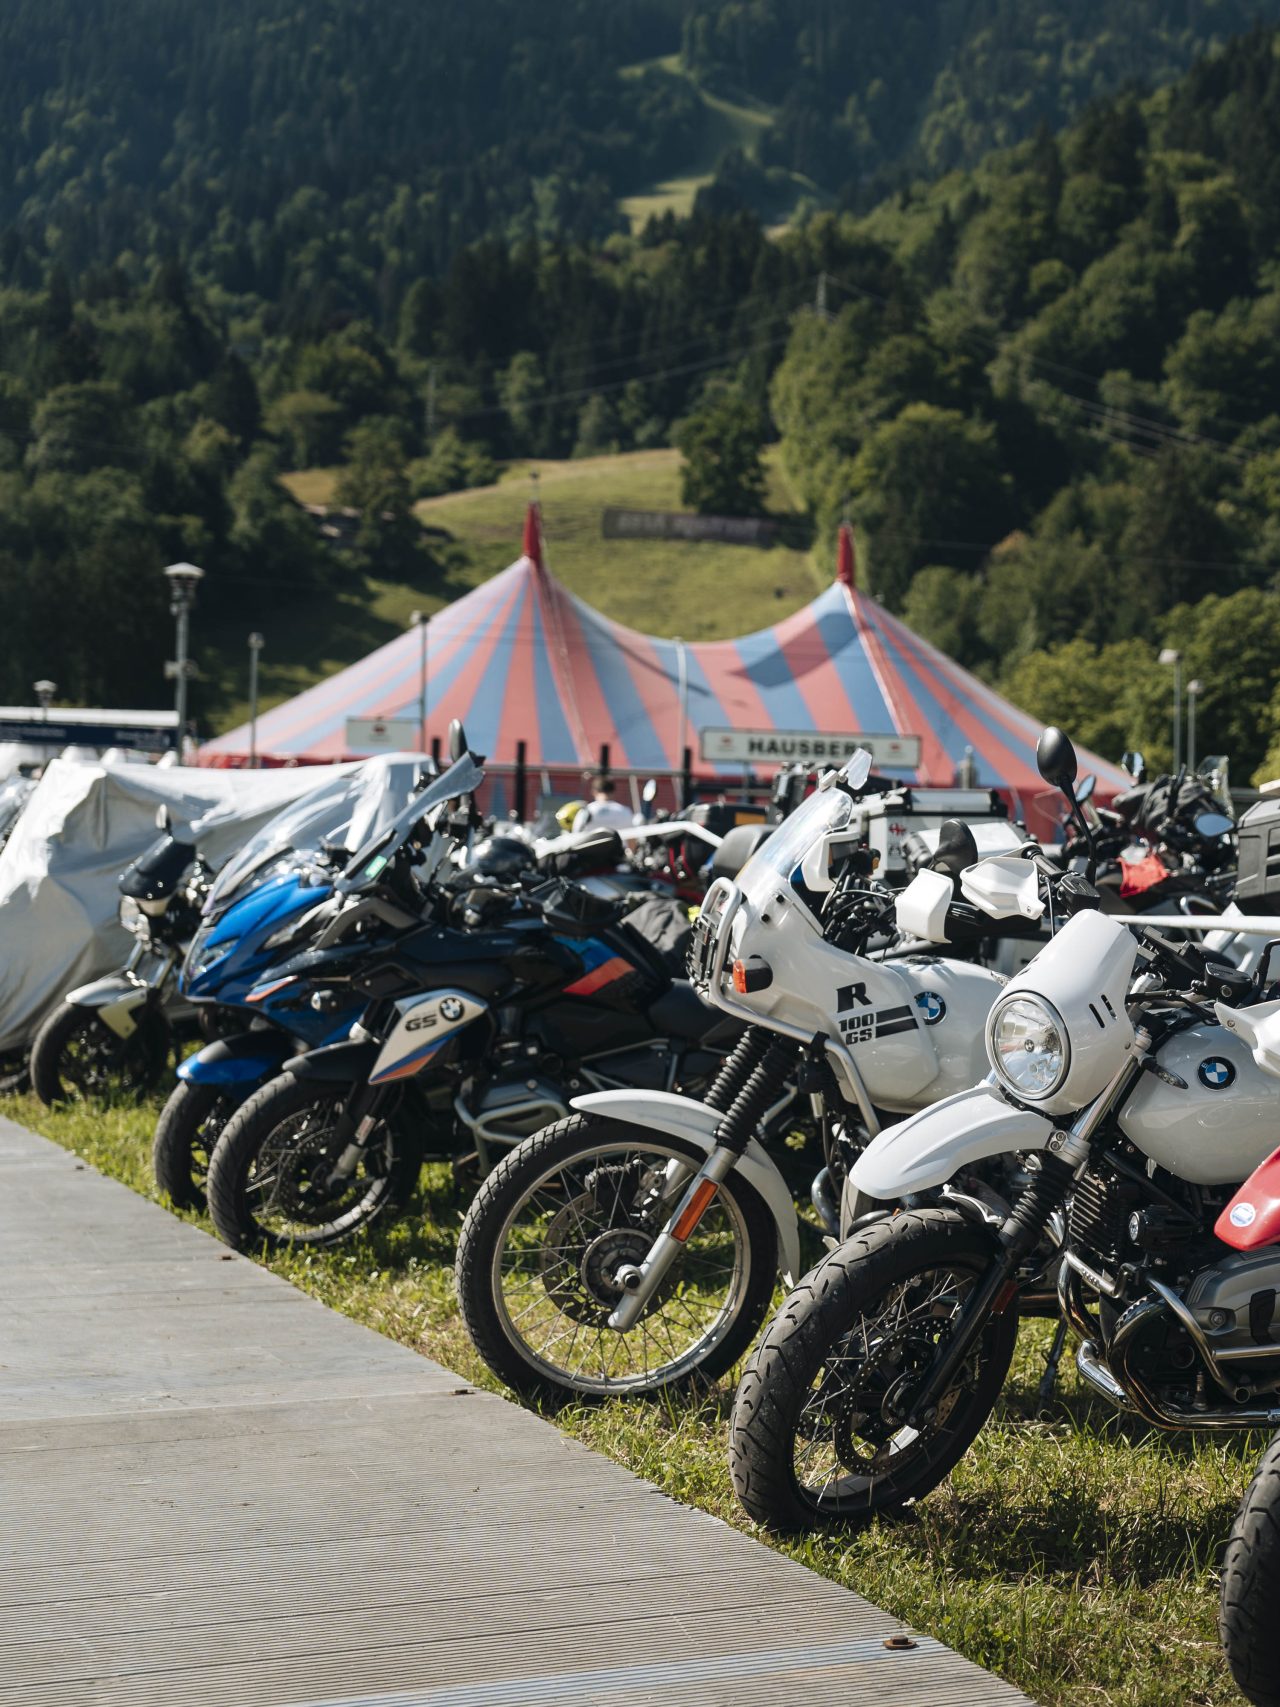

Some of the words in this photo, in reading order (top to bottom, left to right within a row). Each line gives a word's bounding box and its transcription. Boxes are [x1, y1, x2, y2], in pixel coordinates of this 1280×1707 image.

[836, 982, 872, 1013] R
[405, 1014, 437, 1031] GS
[839, 1013, 875, 1032] 100
[845, 1028, 873, 1045] GS
